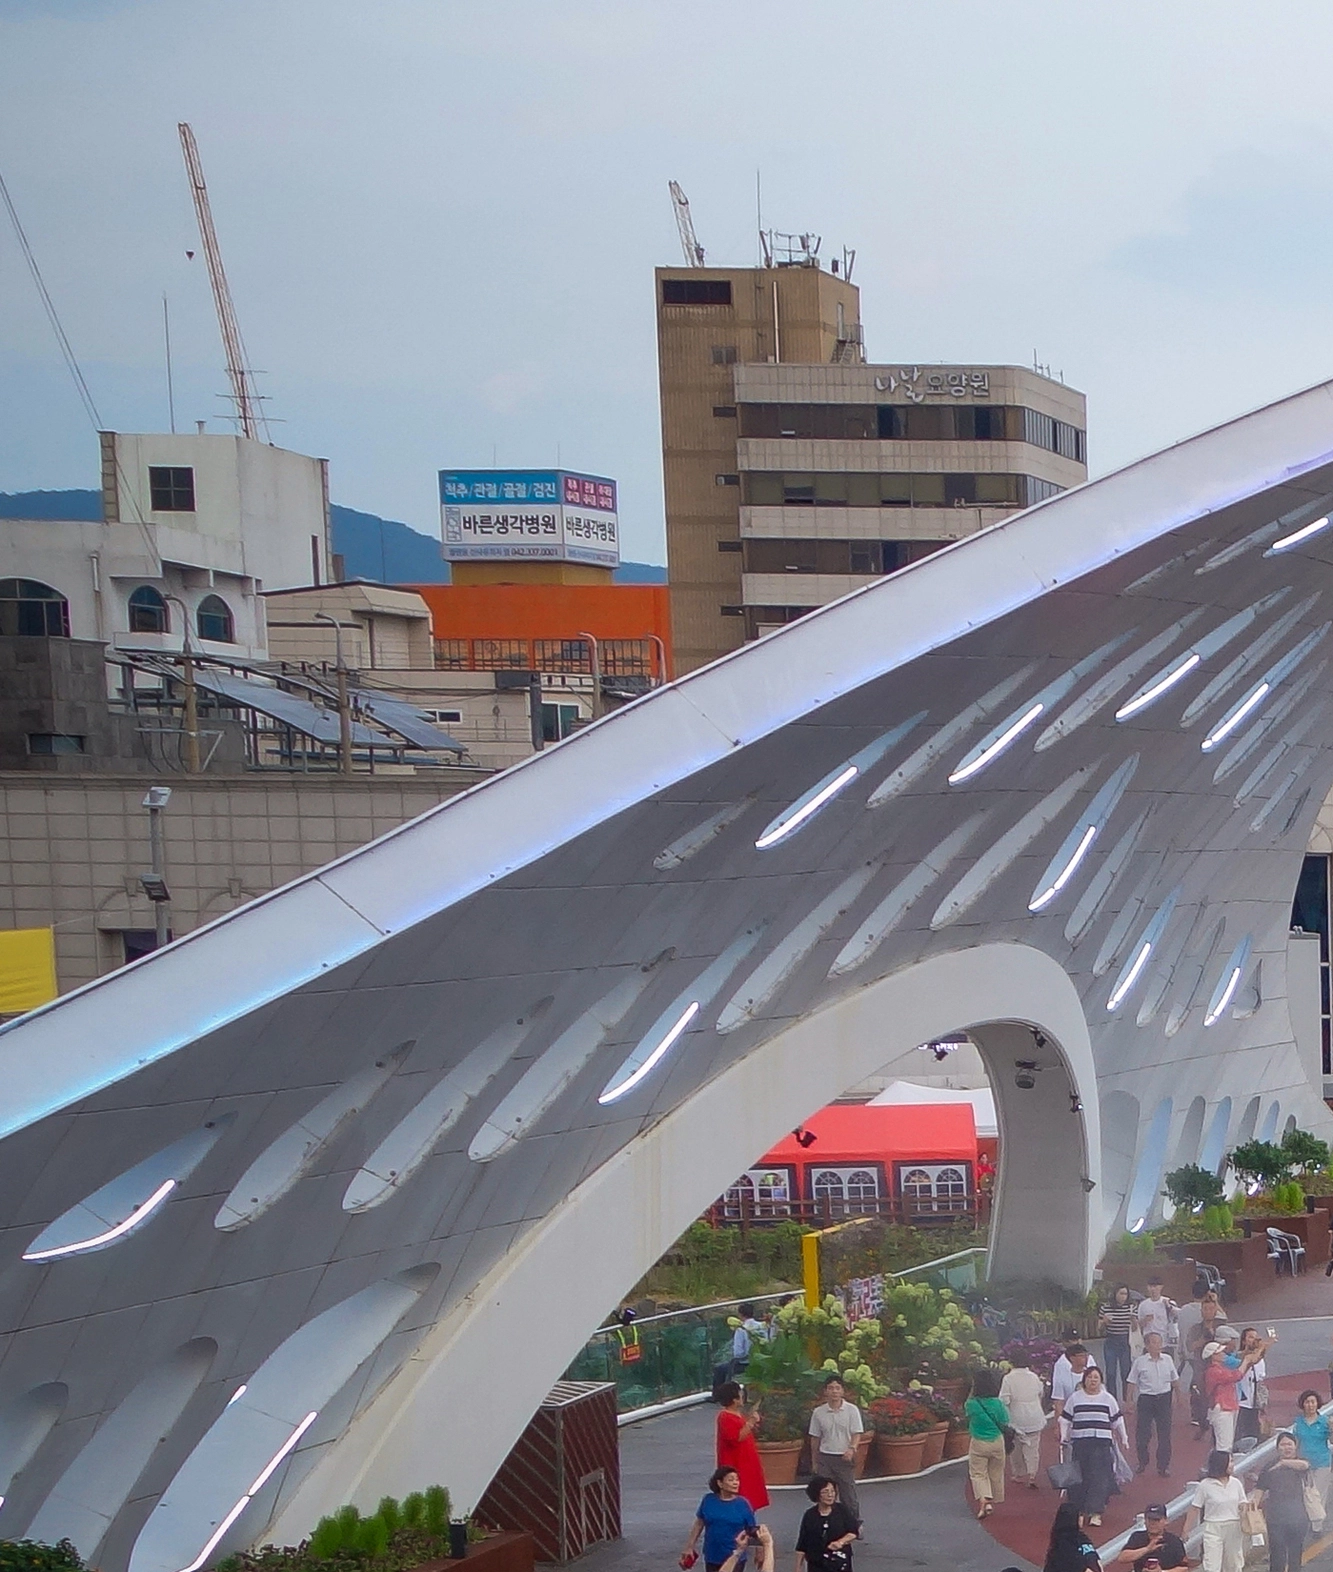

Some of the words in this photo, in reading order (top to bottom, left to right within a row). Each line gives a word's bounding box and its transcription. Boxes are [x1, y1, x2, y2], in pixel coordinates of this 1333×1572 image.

[926, 373, 990, 397] 요양원
[462, 514, 557, 535] 바른생각병원
[566, 516, 615, 543] 바른생각병원
